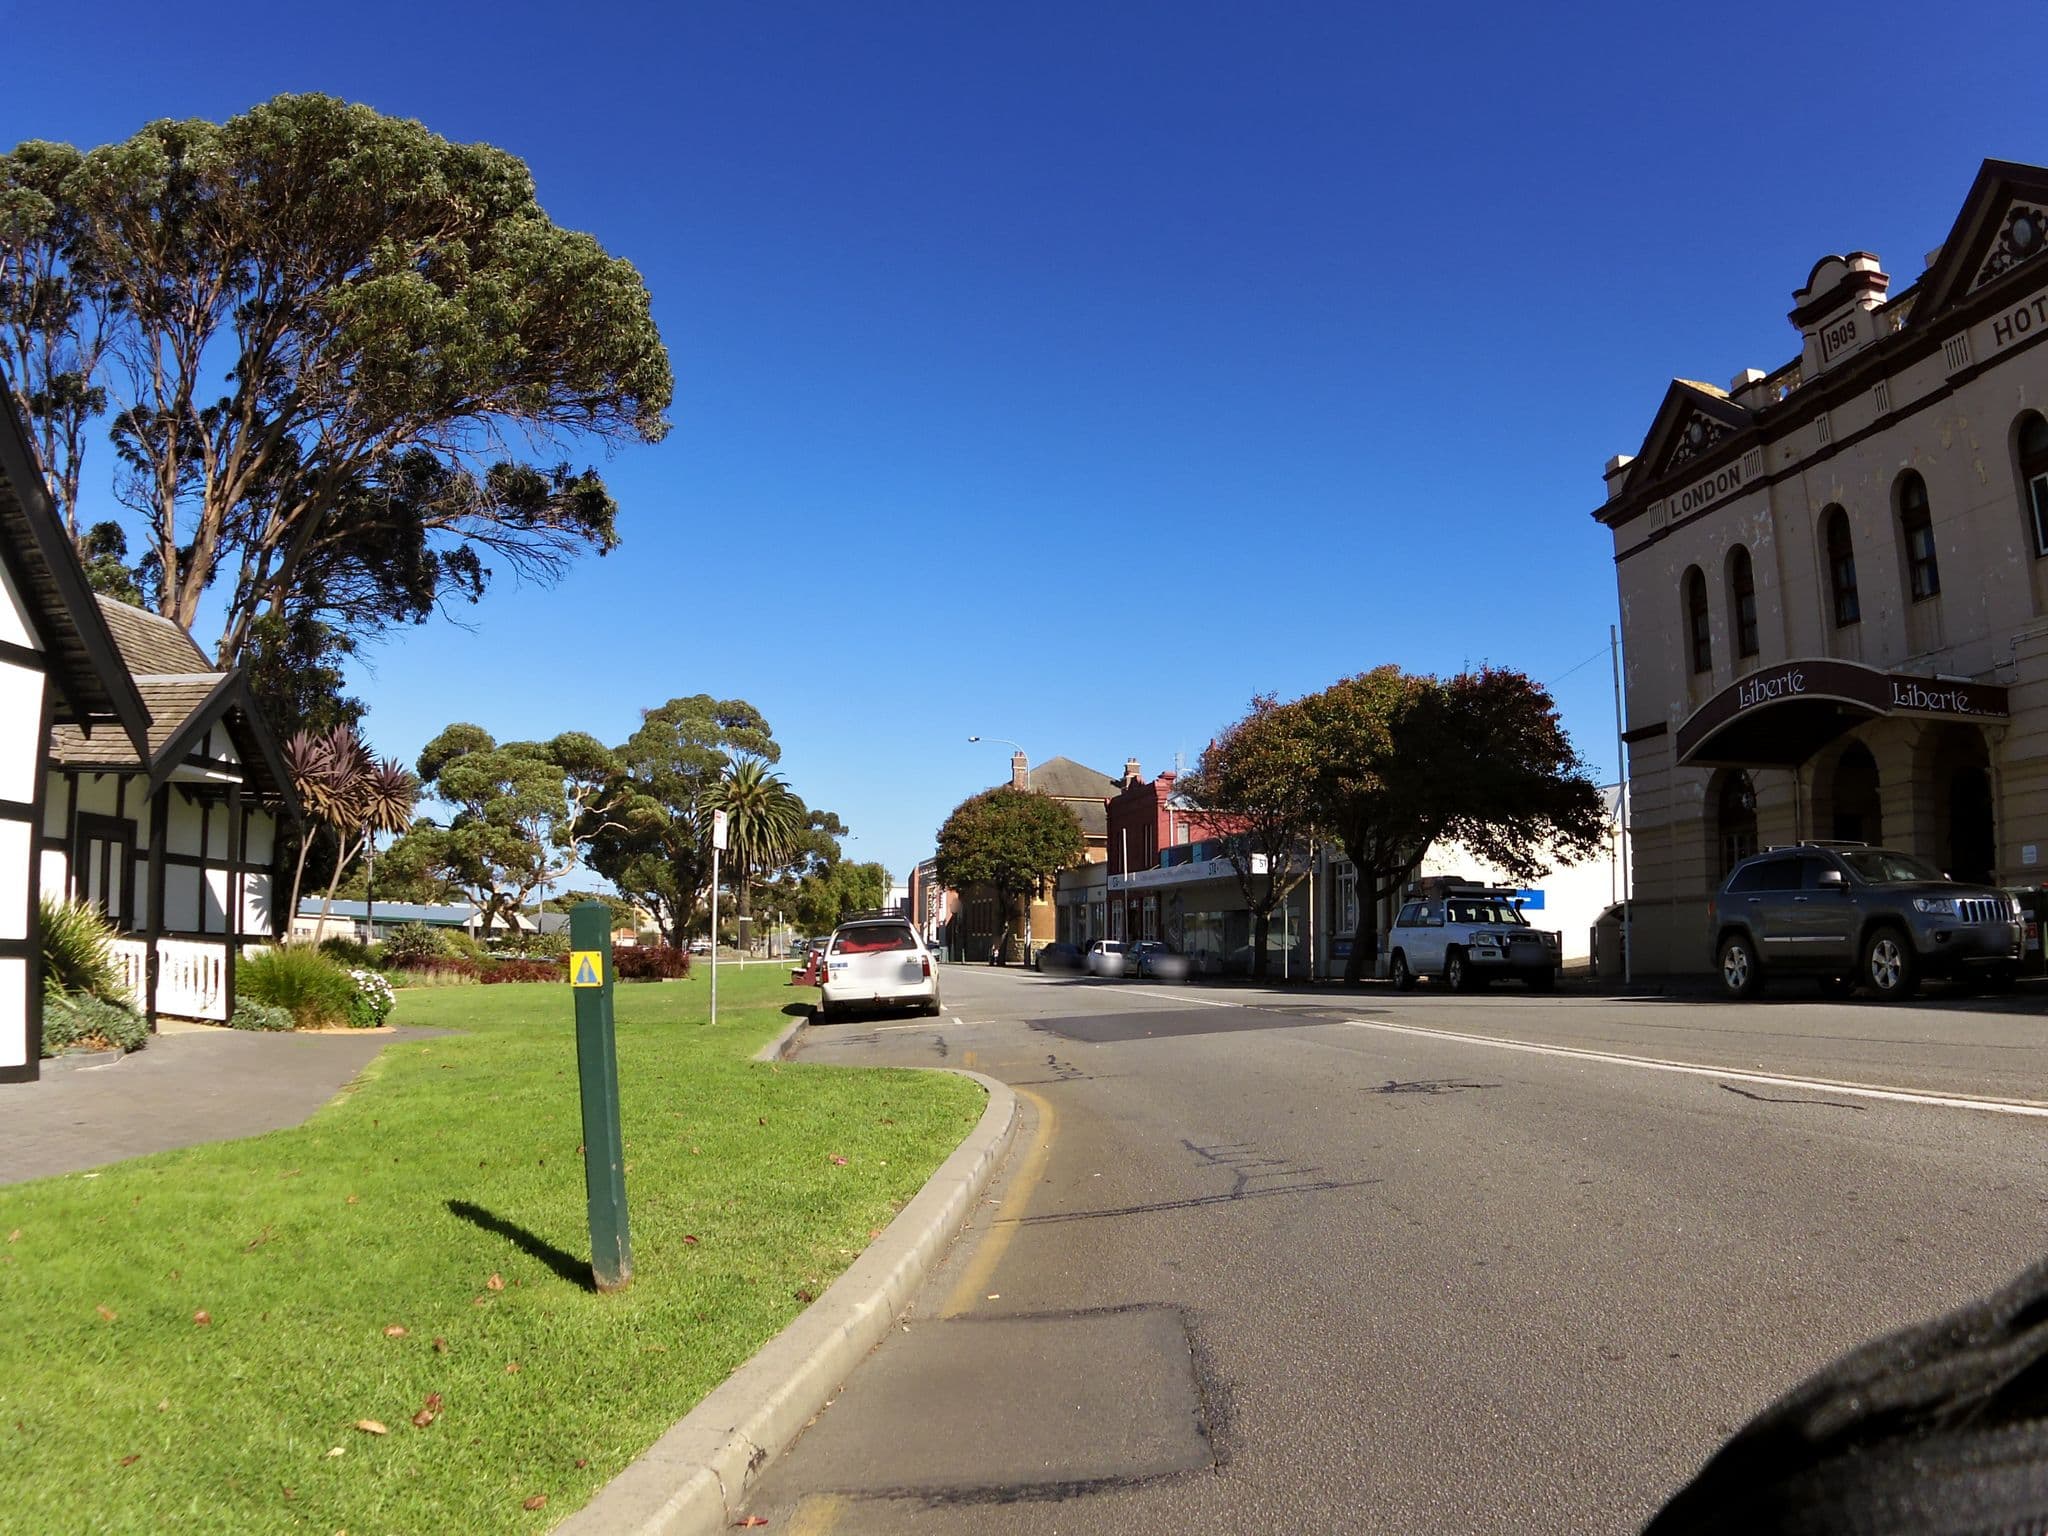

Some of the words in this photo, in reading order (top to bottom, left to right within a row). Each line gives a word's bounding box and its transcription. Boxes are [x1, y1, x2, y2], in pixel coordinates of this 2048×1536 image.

[1826, 321, 1856, 353] 1909
[1670, 465, 1741, 519] LONDON
[1738, 668, 1805, 709] Liberté
[1892, 682, 1970, 713] Liberté
